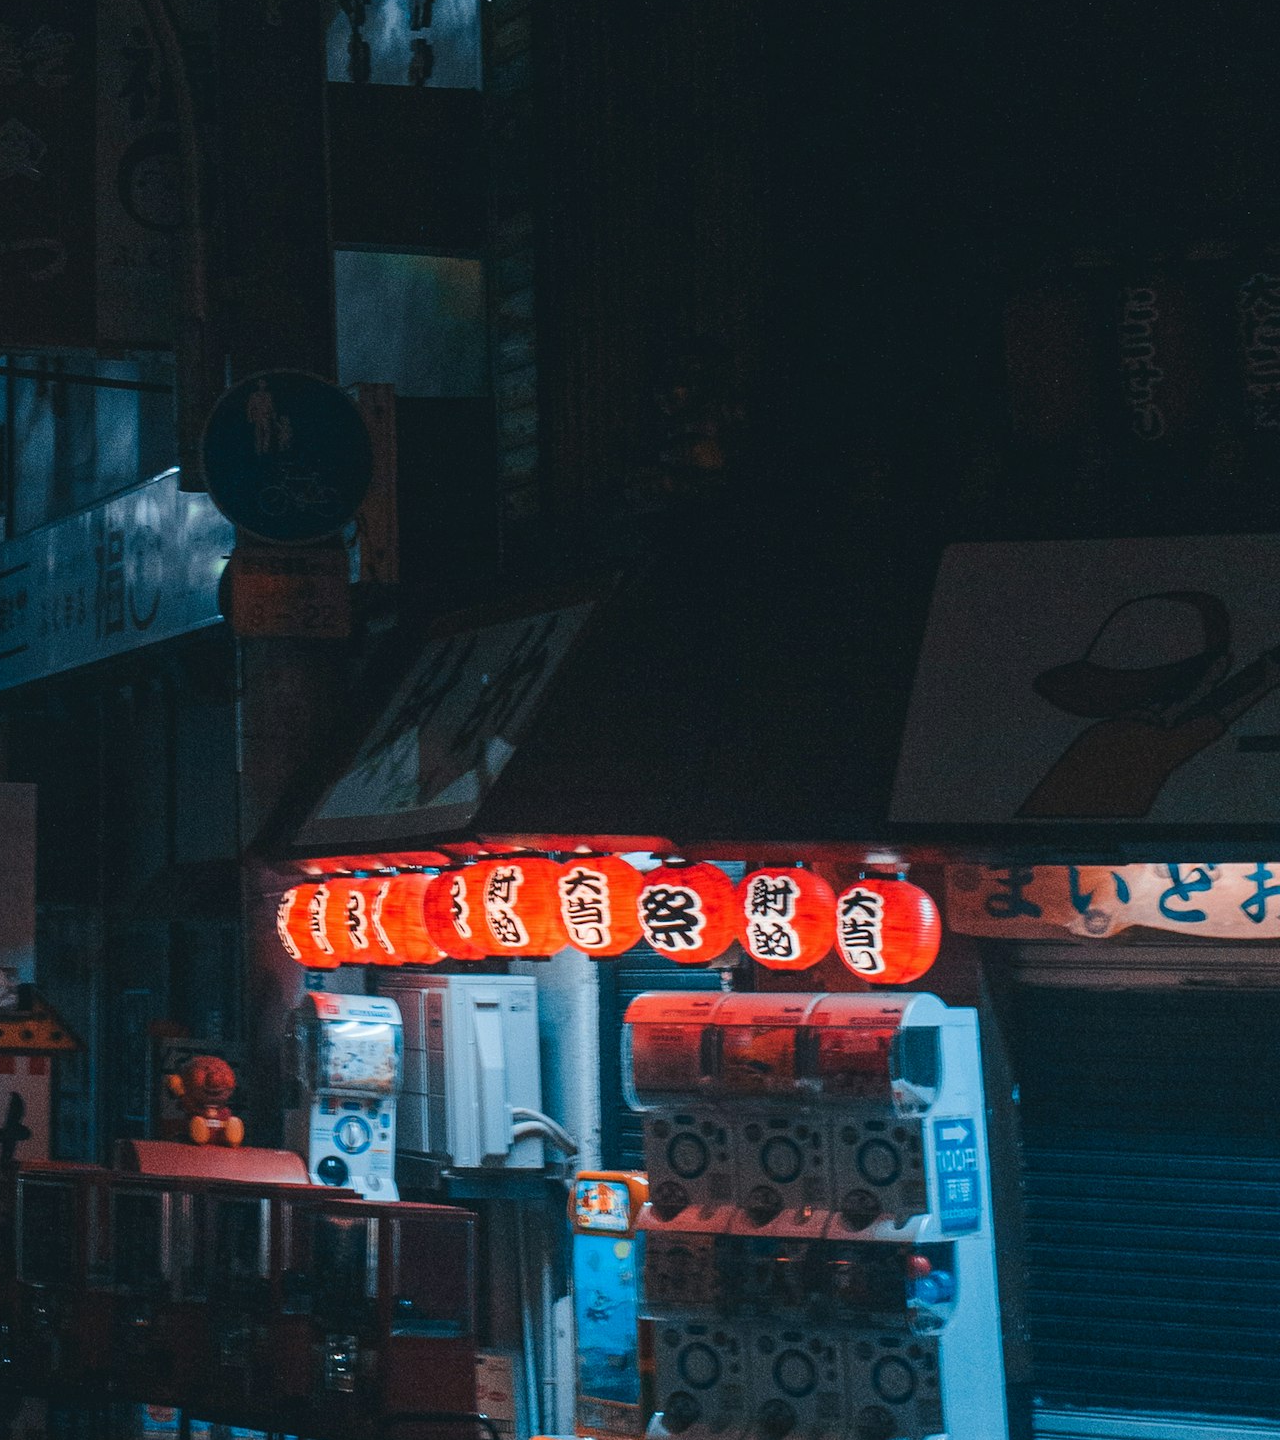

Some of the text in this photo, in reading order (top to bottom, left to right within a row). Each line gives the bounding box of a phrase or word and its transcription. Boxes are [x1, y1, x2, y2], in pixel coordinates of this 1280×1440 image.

[564, 870, 603, 946] 大当り
[642, 888, 699, 949] 祭
[750, 878, 795, 958] 射的
[841, 890, 880, 972] 大当り
